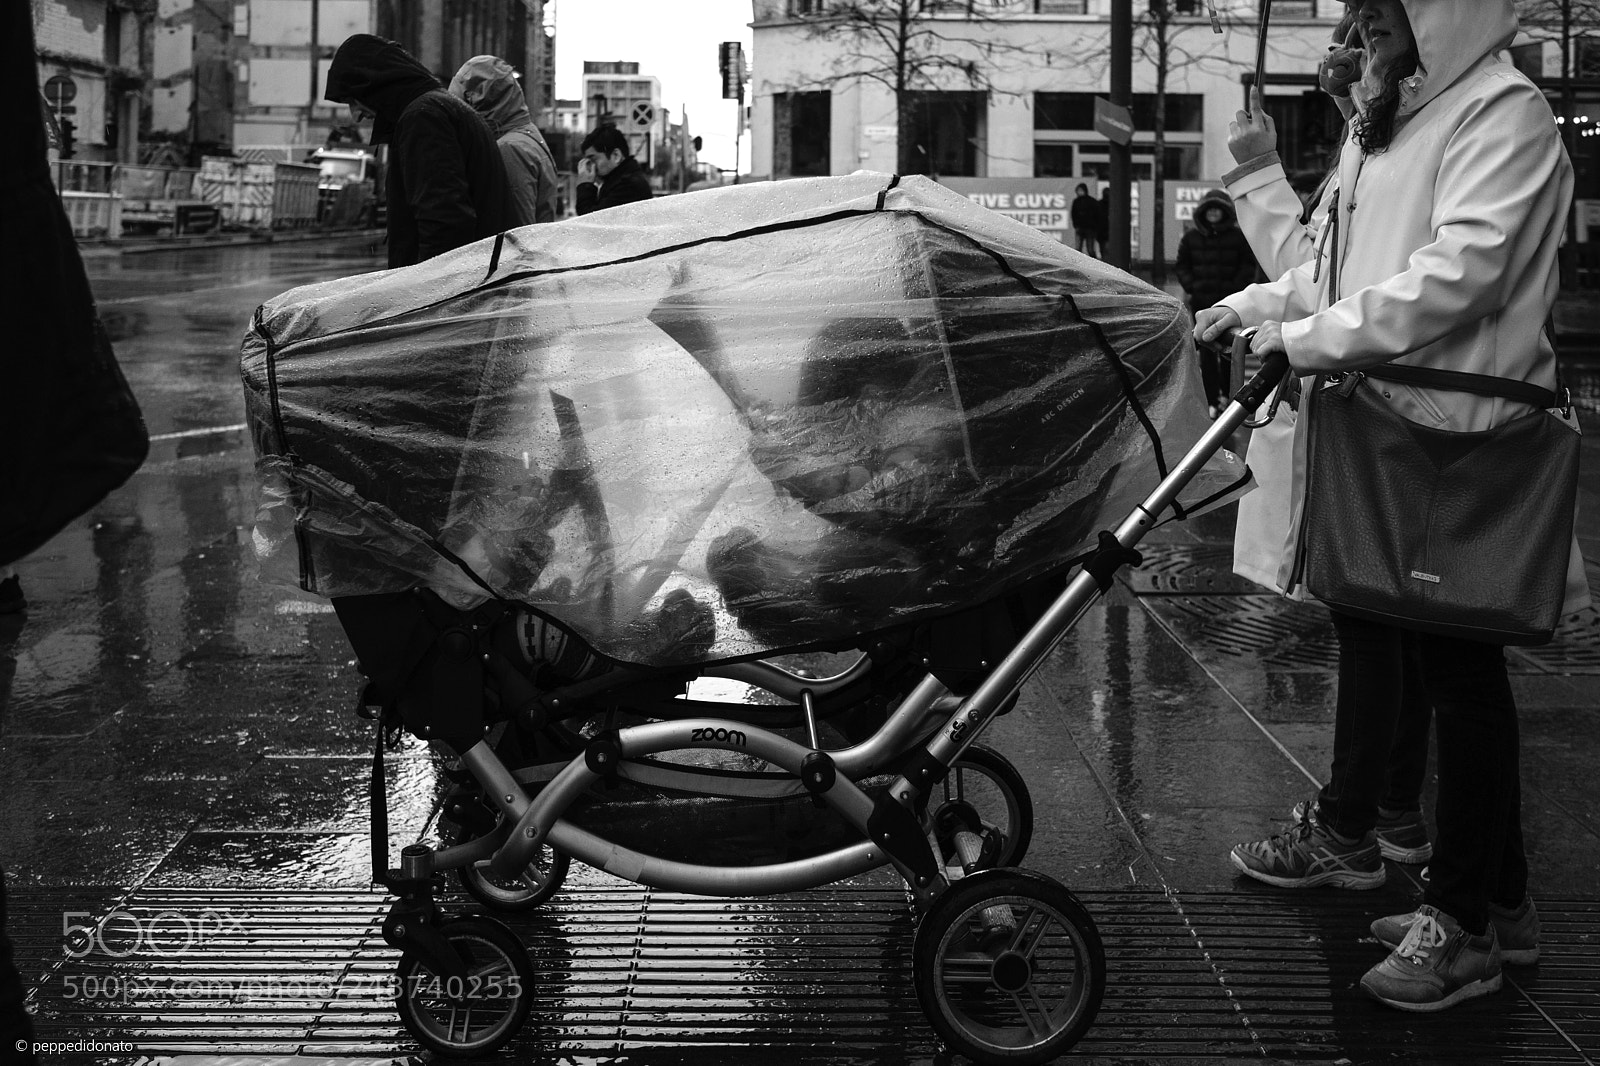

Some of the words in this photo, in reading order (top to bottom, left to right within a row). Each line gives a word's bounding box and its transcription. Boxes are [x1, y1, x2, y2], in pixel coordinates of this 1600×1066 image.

[968, 193, 1010, 208] FIVE
[1014, 193, 1066, 208] GUYS
[1041, 410, 1055, 424] ABC
[1057, 388, 1085, 411] DESIGN
[691, 727, 747, 746] zoom
